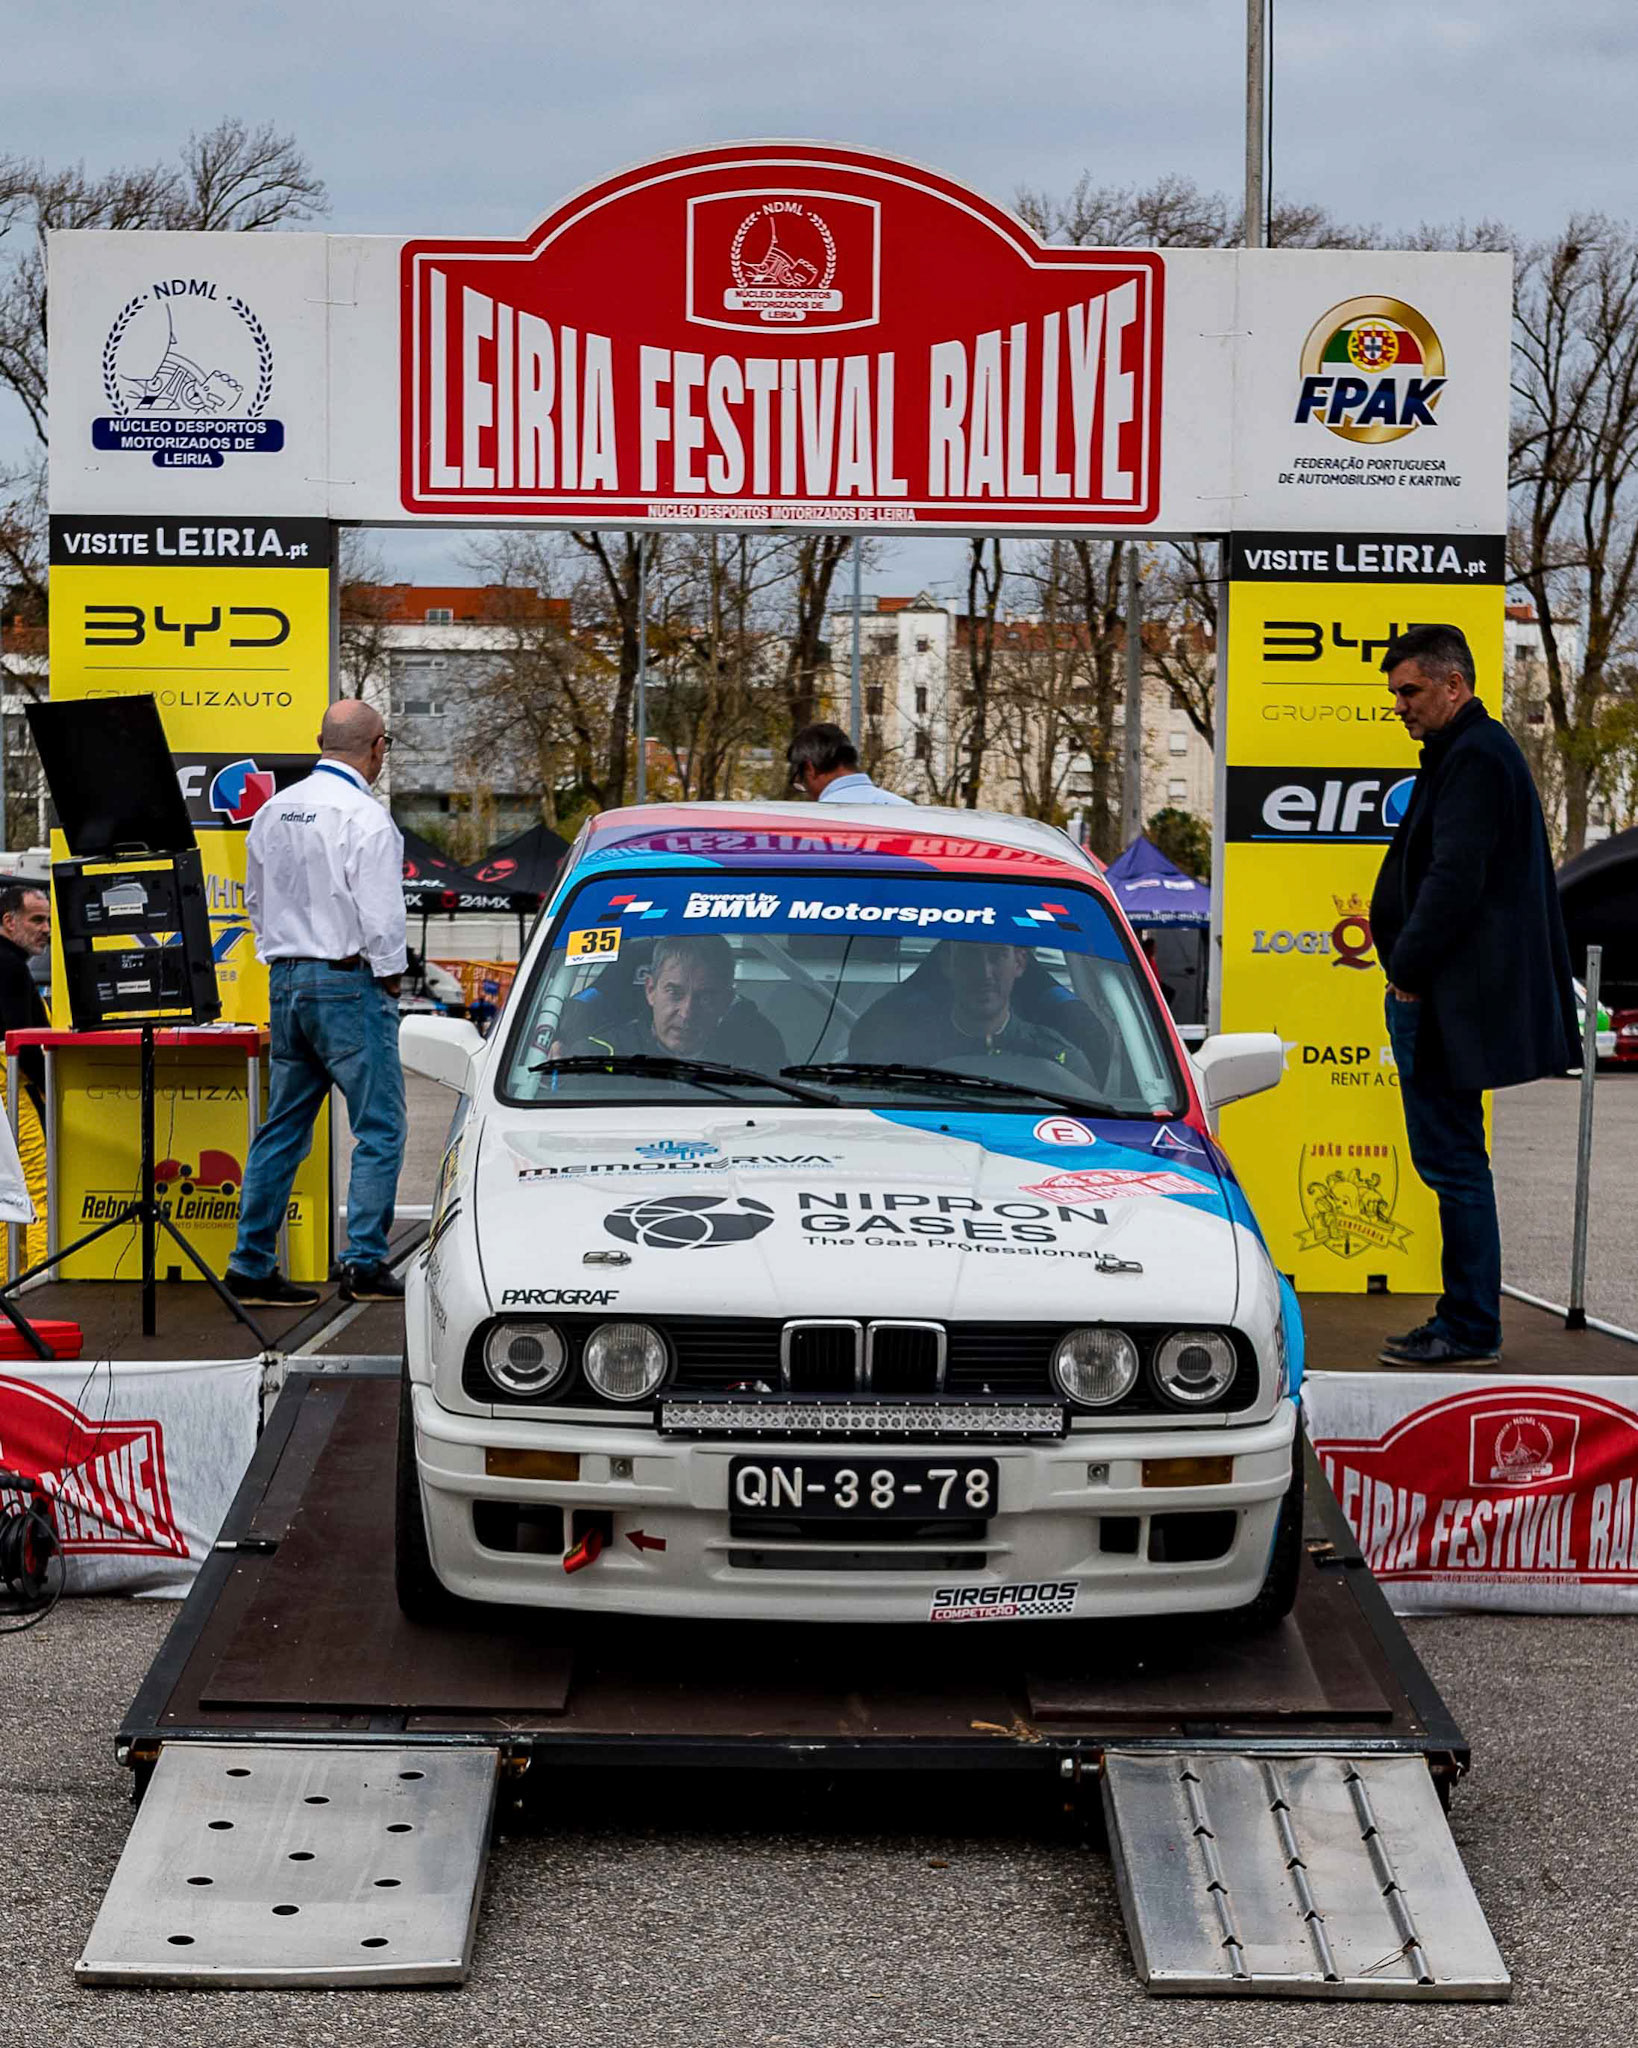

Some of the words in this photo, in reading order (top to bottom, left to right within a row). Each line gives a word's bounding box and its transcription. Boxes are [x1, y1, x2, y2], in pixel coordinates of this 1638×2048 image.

[762, 201, 803, 217] NDML
[152, 278, 218, 301] NDML
[429, 267, 619, 491] LEIRIA
[639, 345, 909, 497] FESTIVAL
[928, 278, 1138, 501] RALLYE
[1294, 376, 1448, 426] FPAK
[175, 421, 267, 433] DESPORTOS
[121, 437, 231, 449] MOTORIZADOS
[234, 438, 255, 449] DE
[164, 453, 212, 465] LEIRIA
[1293, 457, 1364, 472] FEDERAÇÃO
[1366, 459, 1446, 471] PORTUGUESA
[1278, 473, 1295, 484] DE
[1297, 474, 1395, 485] AUTOMOBILISMO
[1398, 475, 1406, 485] E
[1409, 476, 1461, 487] KARTING
[699, 505, 768, 519] DESPORTOS
[771, 506, 856, 520] MOTORIZADOS
[858, 508, 874, 520] DE
[877, 508, 916, 521] LEIRIA
[63, 533, 149, 554] VISITE
[1244, 549, 1329, 571] VISITE
[85, 605, 290, 647] BYD
[1262, 780, 1380, 832] elf
[459, 893, 511, 910] 24MX
[690, 893, 756, 901] Powered
[758, 893, 779, 903] by
[683, 901, 782, 918] BMW
[787, 901, 996, 927] Motorsport
[581, 930, 617, 953] 35
[1303, 1047, 1370, 1065] DASP
[1331, 1072, 1370, 1086] RENT
[1374, 1073, 1385, 1086] A
[1051, 1128, 1079, 1142] E
[799, 1192, 1109, 1225] NIPPON
[801, 1213, 1057, 1243] GASES
[803, 1236, 854, 1247] The
[864, 1236, 918, 1249] Gas
[928, 1238, 1118, 1260] Professionals
[501, 1289, 620, 1305] PARCIGRAF
[736, 1465, 991, 1510] QN-38-78
[1429, 1492, 1577, 1569] FESTIVAL
[1588, 1477, 1638, 1571] RA
[934, 1583, 1079, 1606] SIRGADOS
